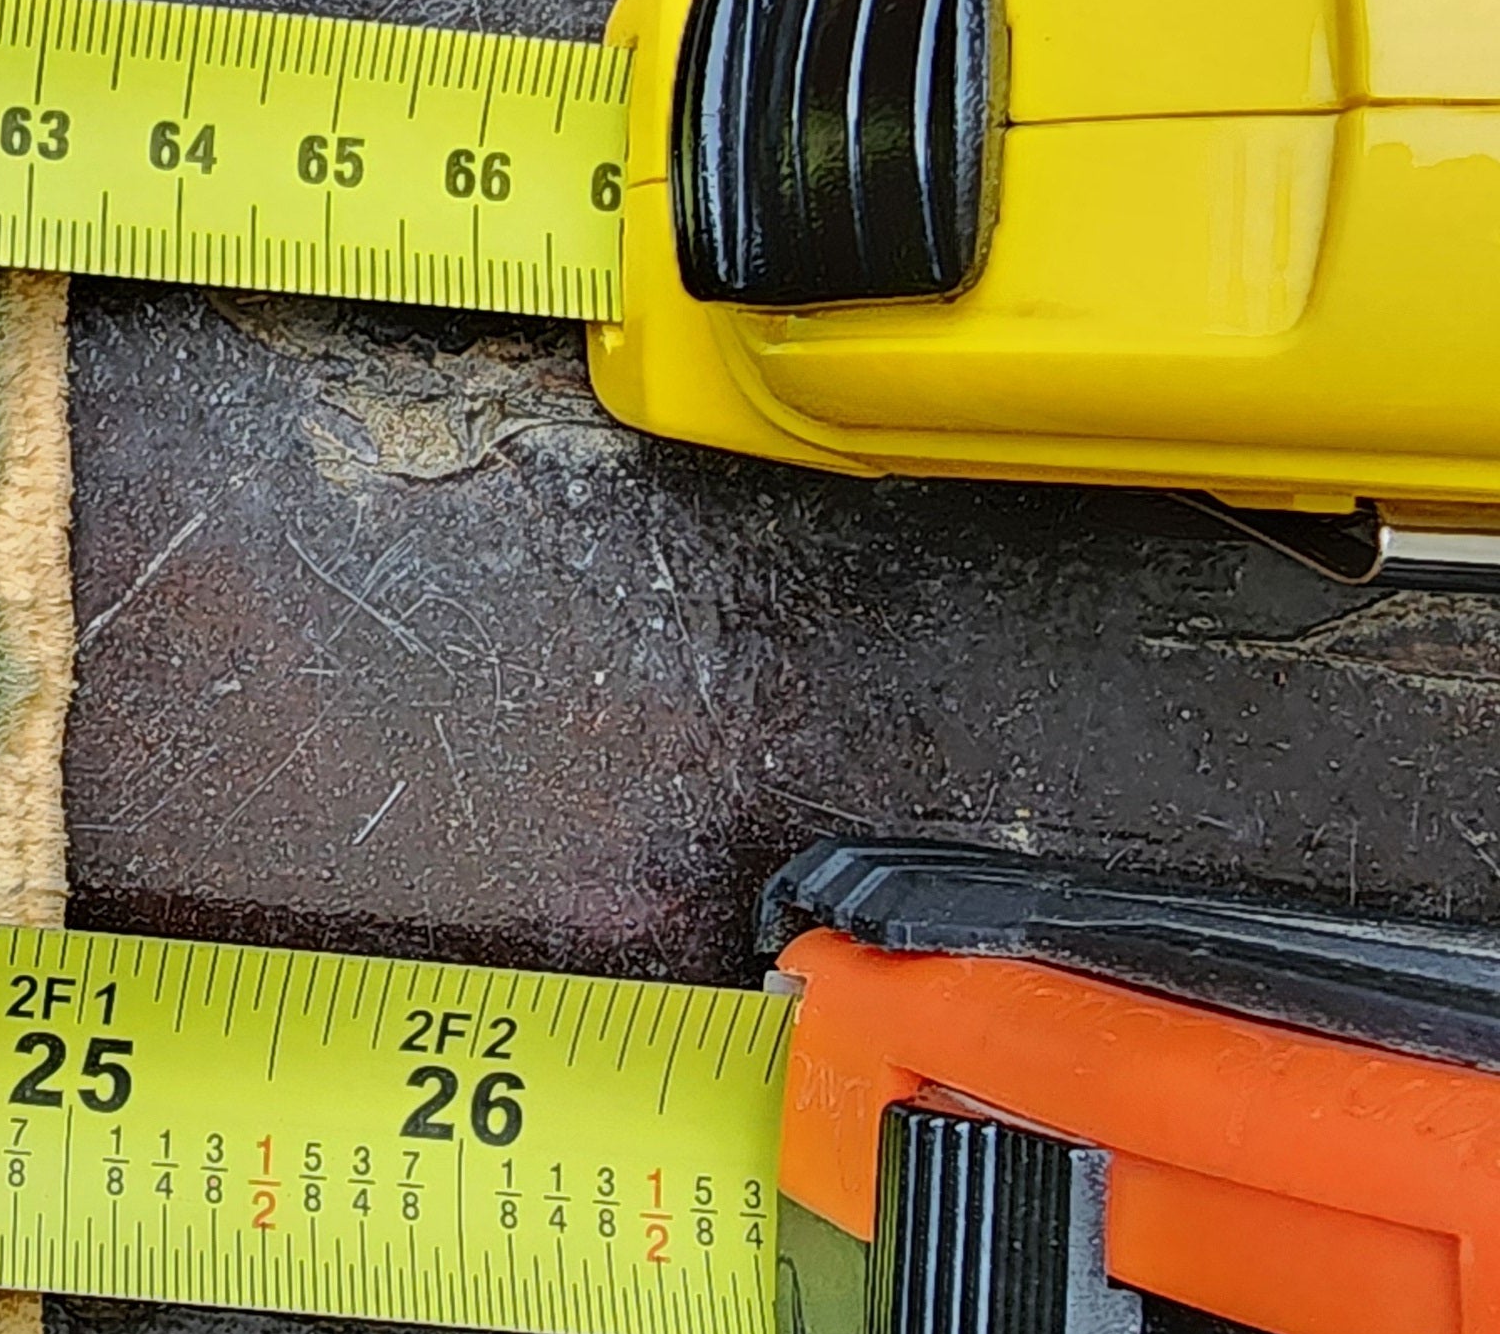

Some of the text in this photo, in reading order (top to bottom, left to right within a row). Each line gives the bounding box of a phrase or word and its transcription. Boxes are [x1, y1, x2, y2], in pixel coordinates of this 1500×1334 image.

[0, 107, 69, 160] 63
[149, 121, 217, 174] 64
[297, 136, 365, 188] 65
[445, 149, 511, 201] 66
[591, 162, 621, 212] 6
[5, 975, 117, 1025] 2F 1
[400, 1010, 517, 1059] 2F 2
[8, 1031, 133, 1113] 25
[400, 1065, 525, 1147] 26
